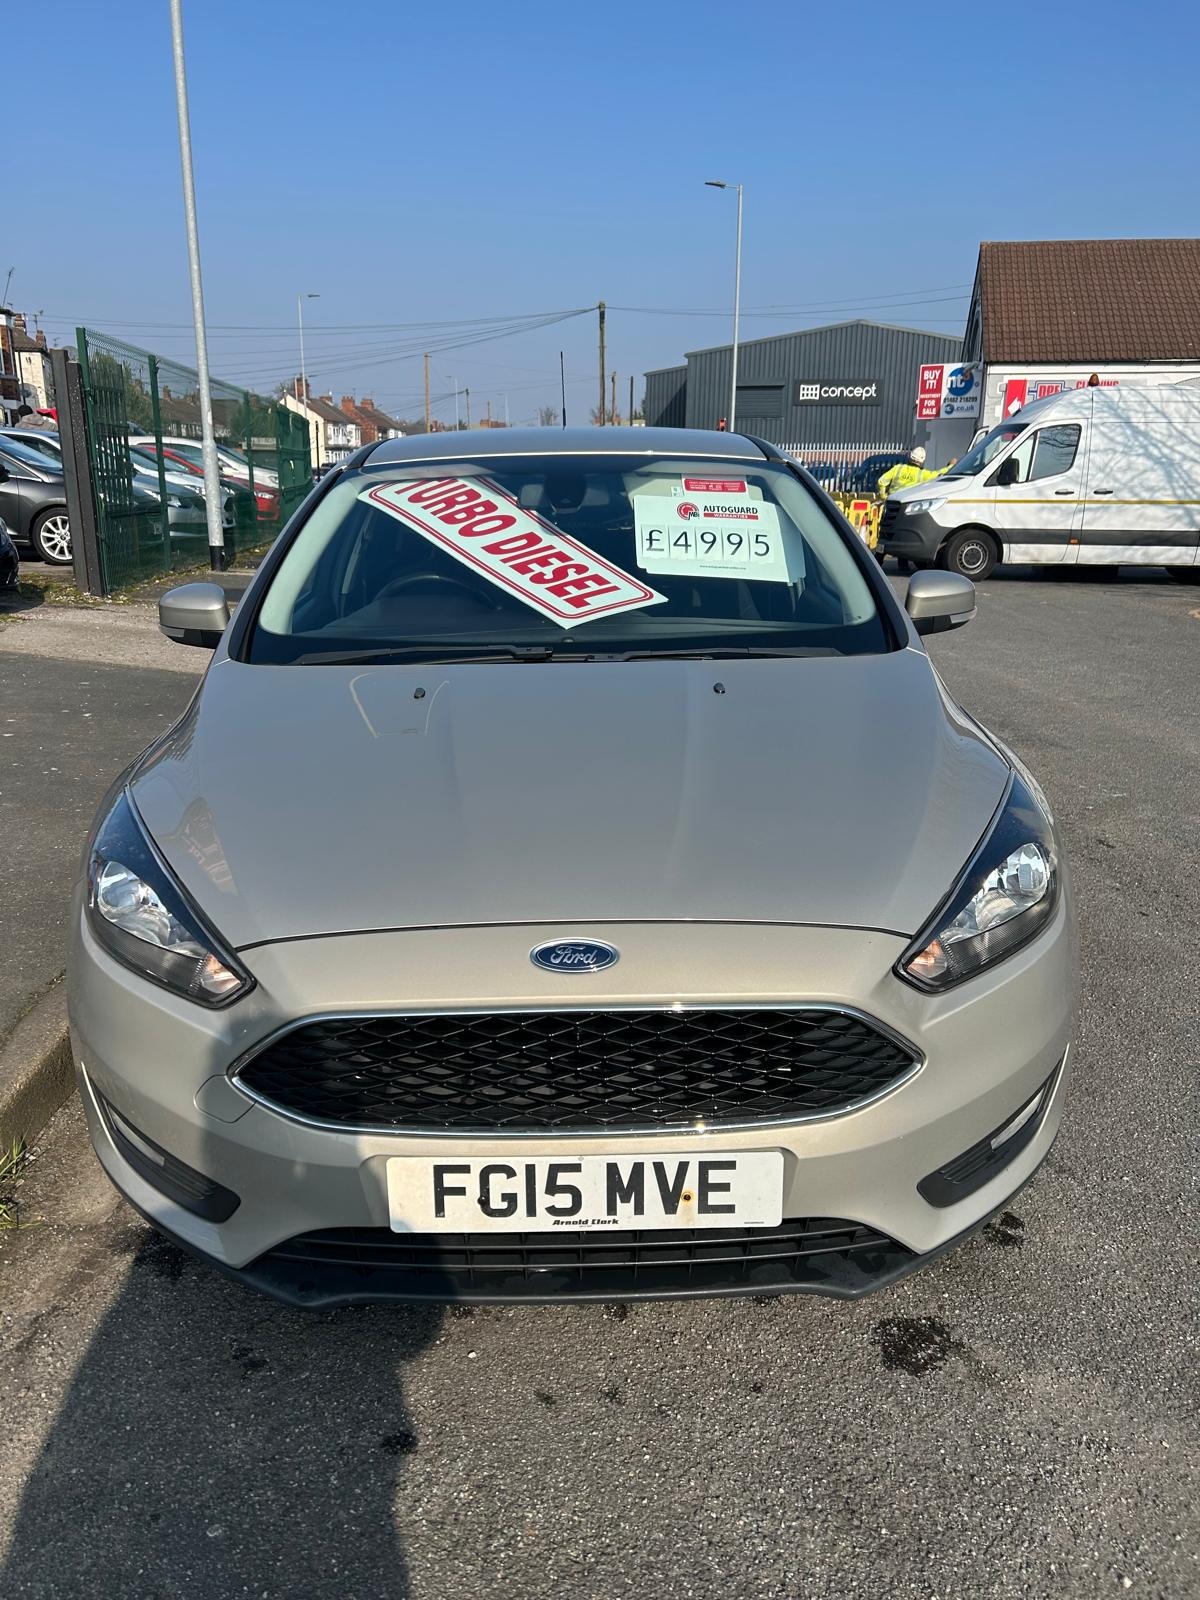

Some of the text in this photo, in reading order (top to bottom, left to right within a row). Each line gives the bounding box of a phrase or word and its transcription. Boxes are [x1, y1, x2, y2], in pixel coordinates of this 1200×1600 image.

[923, 370, 941, 380] BUY
[821, 383, 877, 400] concept
[926, 380, 936, 389] IT!
[703, 505, 758, 514] AUTOGUARD
[395, 476, 621, 609] TURBO DIESEL
[645, 529, 770, 557] £4995
[550, 945, 598, 964] Ford
[433, 1160, 737, 1218] FG15 MVE
